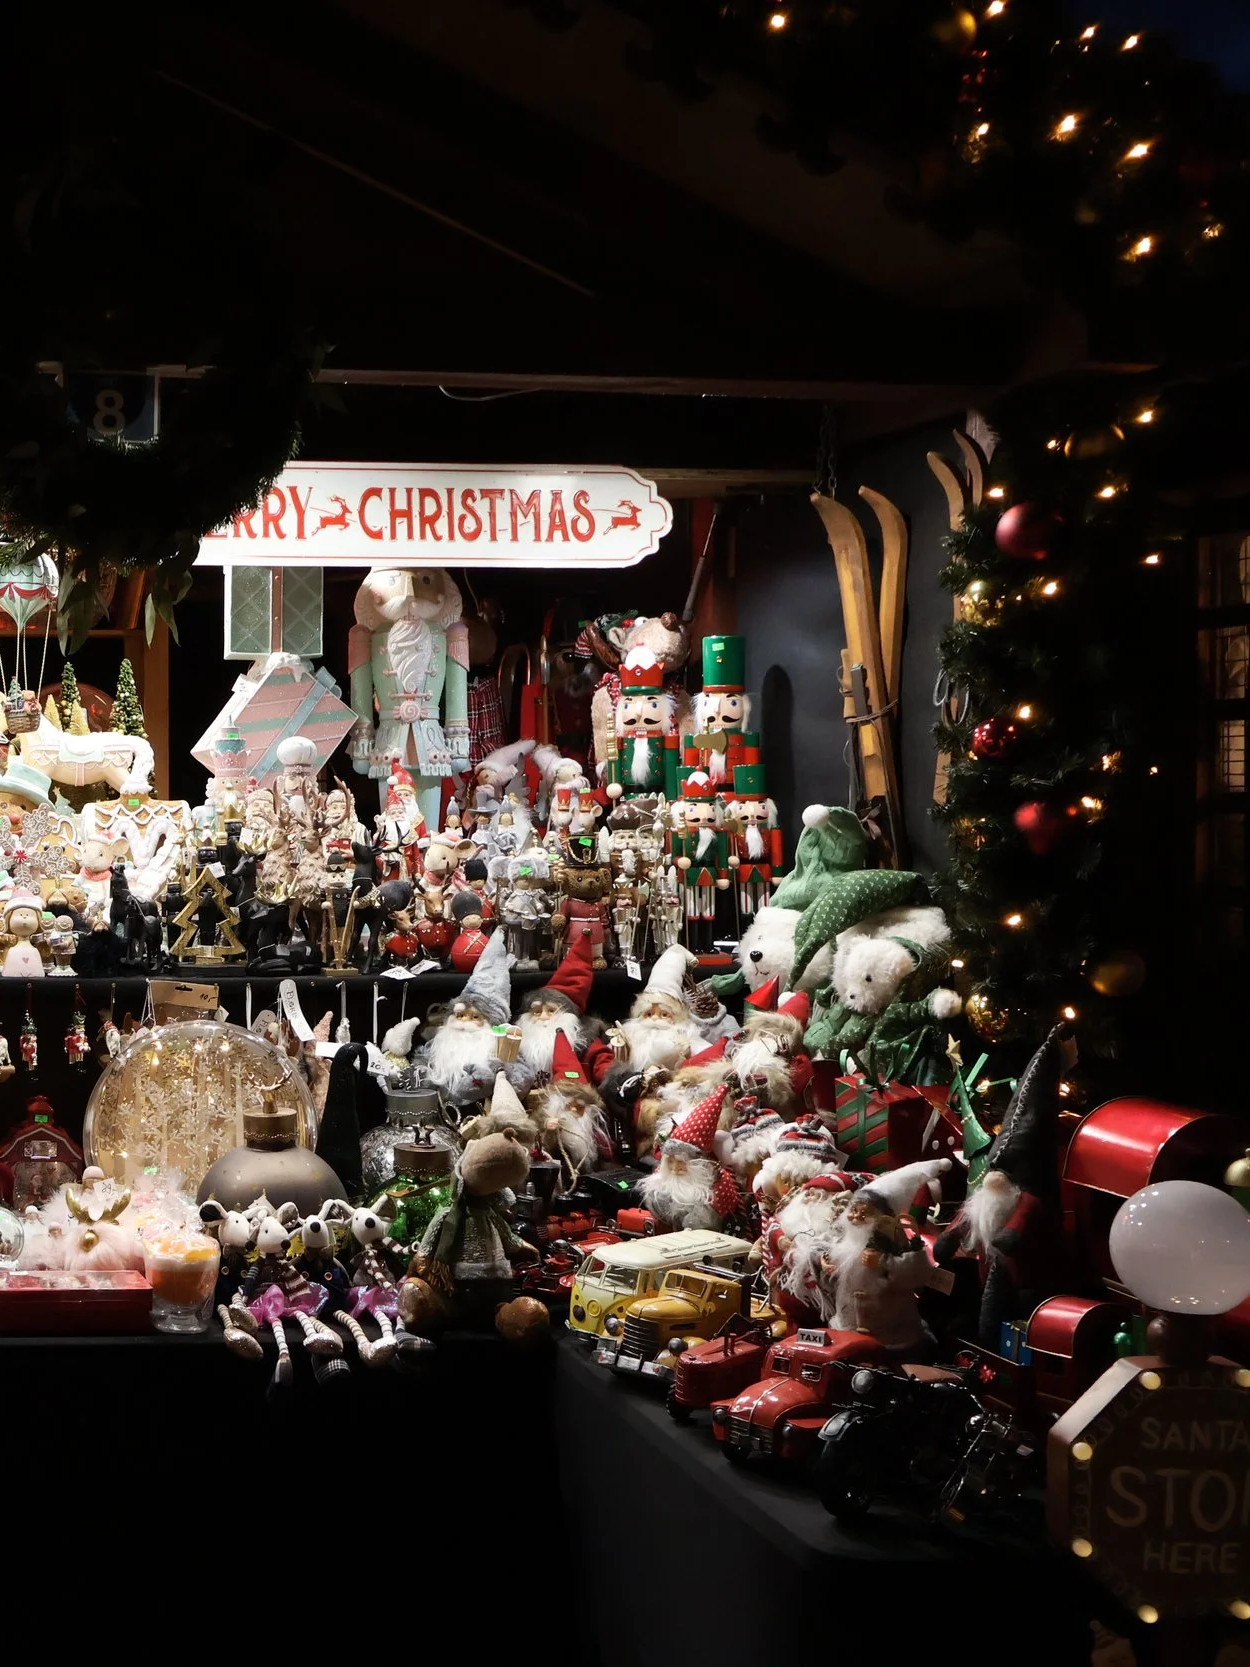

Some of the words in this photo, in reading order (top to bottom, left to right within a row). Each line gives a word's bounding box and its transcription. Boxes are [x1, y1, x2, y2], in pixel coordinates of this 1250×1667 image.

[92, 389, 126, 435] 8
[200, 485, 313, 540] RRY
[357, 486, 596, 543] CHRISTMAS
[800, 1333, 822, 1343] TAXI
[1139, 1416, 1250, 1452] SANTA
[1105, 1465, 1250, 1533] STO
[1142, 1540, 1241, 1574] HERE
